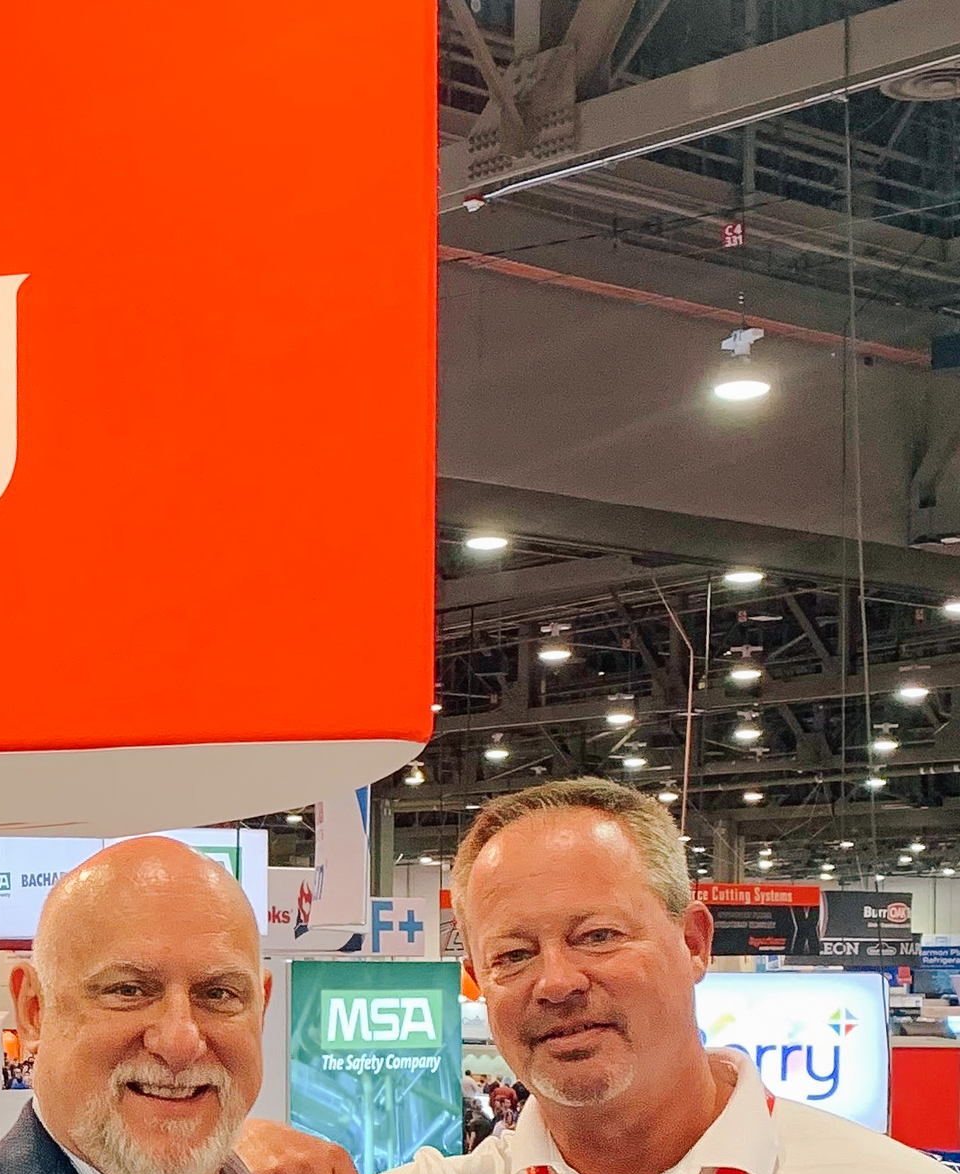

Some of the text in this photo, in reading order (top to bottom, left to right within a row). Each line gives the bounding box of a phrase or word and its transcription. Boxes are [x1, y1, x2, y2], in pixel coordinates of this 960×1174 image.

[712, 886, 751, 904] Cutting
[754, 887, 793, 904] Systems
[327, 998, 436, 1041] MSA
[322, 1054, 441, 1074] The Safety Company
